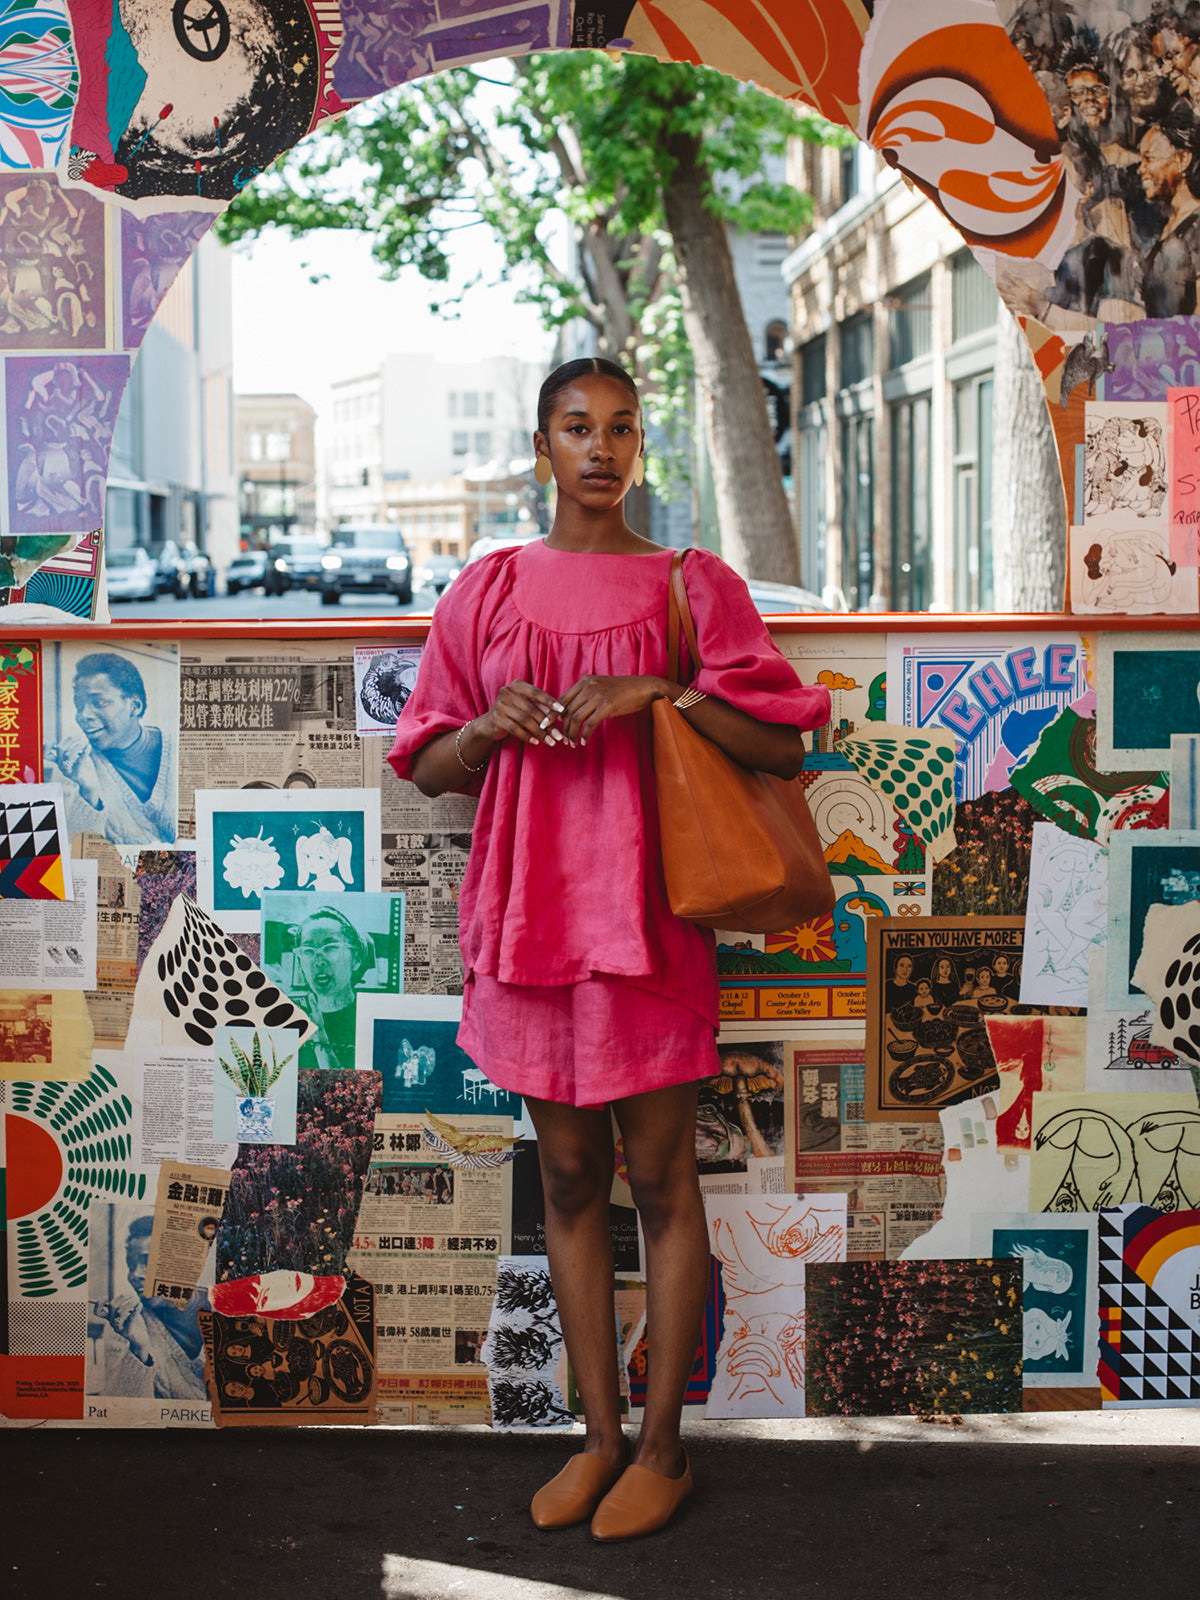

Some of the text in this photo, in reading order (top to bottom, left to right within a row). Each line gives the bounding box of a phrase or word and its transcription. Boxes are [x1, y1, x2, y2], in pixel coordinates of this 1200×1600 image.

[180, 678, 301, 702] 建經調整純利增22%
[180, 704, 274, 728] 規管業務收益佳
[0, 680, 20, 783] 家家平安
[97, 911, 140, 924] 生命鬥士
[887, 933, 925, 947] WHEN
[928, 932, 949, 946] YOU
[952, 931, 982, 946] HAVE
[984, 931, 1017, 945] MORE
[722, 1000, 744, 1009] Chapel
[787, 1000, 797, 1009] for
[794, 1008, 811, 1016] Valley
[513, 1233, 535, 1242] Henry
[353, 1286, 371, 1323] NOT A
[89, 1406, 107, 1418] Pat
